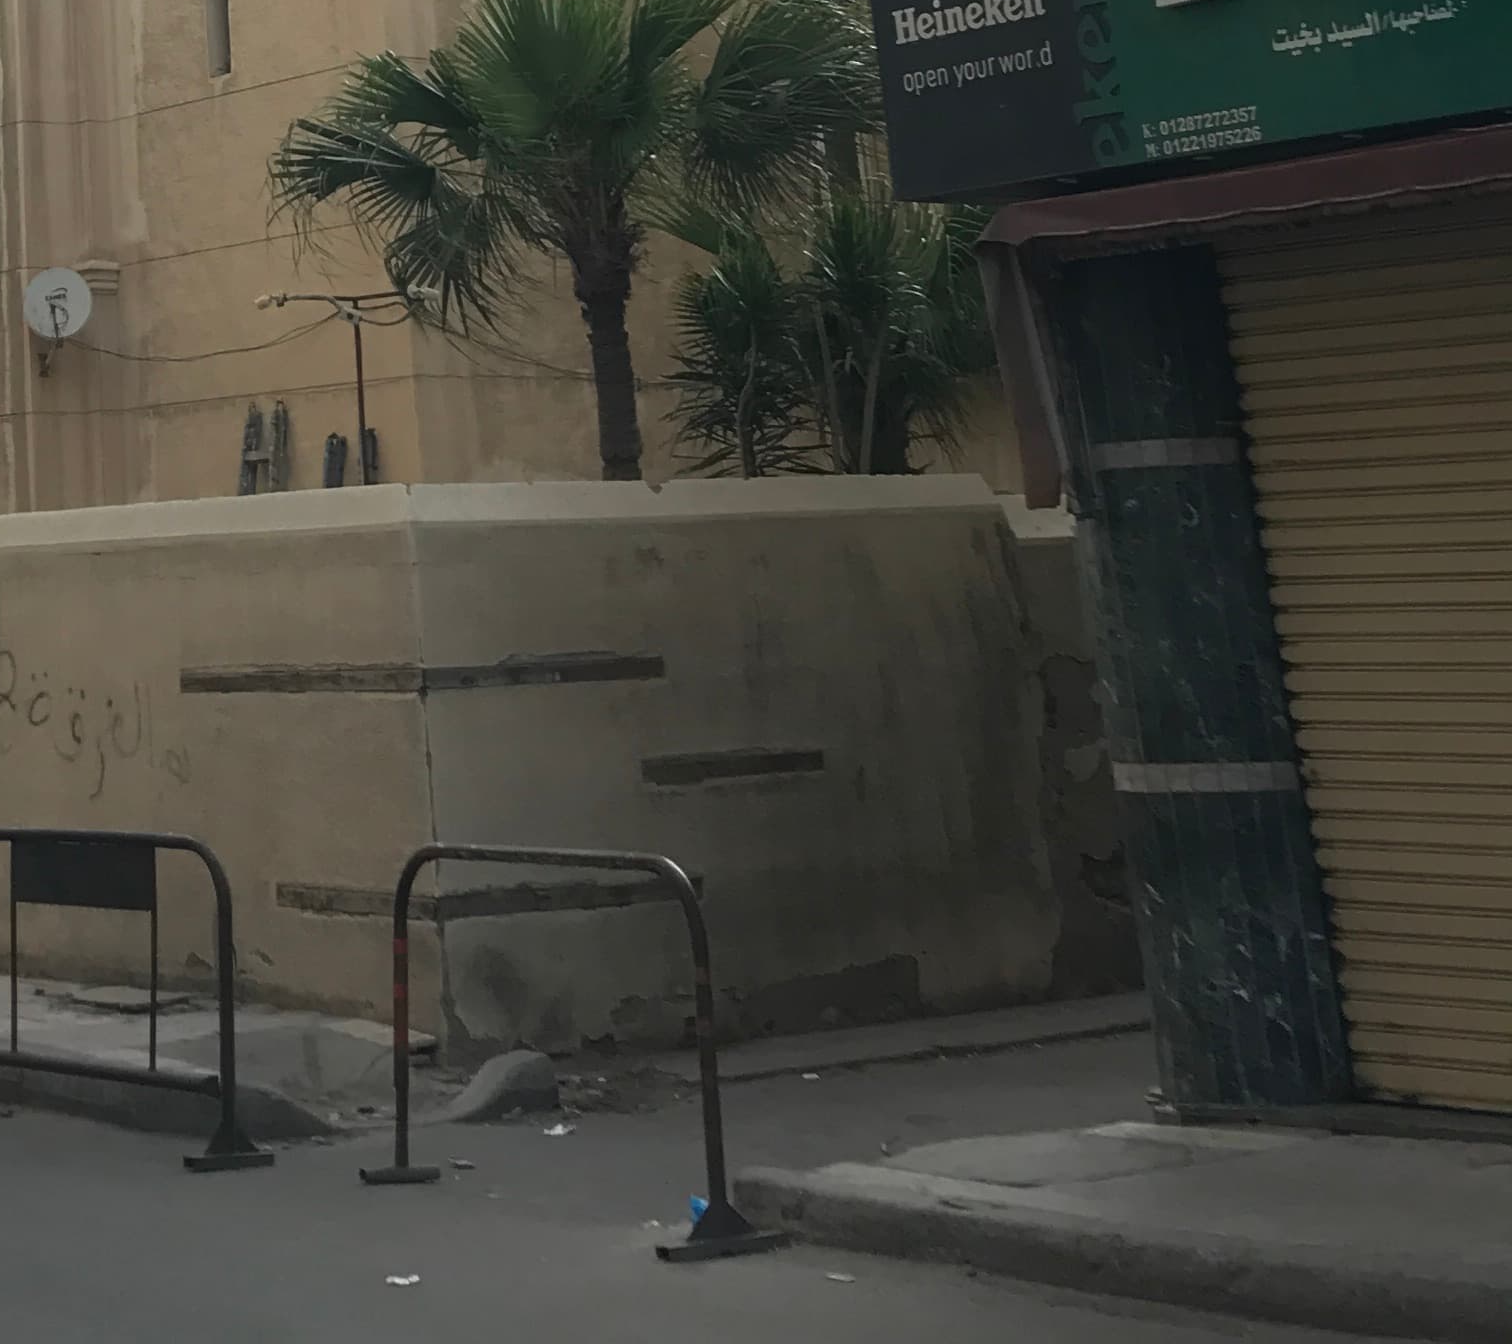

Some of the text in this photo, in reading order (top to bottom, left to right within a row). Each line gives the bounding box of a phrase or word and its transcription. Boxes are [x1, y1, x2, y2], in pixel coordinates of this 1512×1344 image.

[1272, 22, 1322, 56] بخيت
[903, 41, 1053, 95] open your word
[1163, 126, 1262, 155] 01221975226
